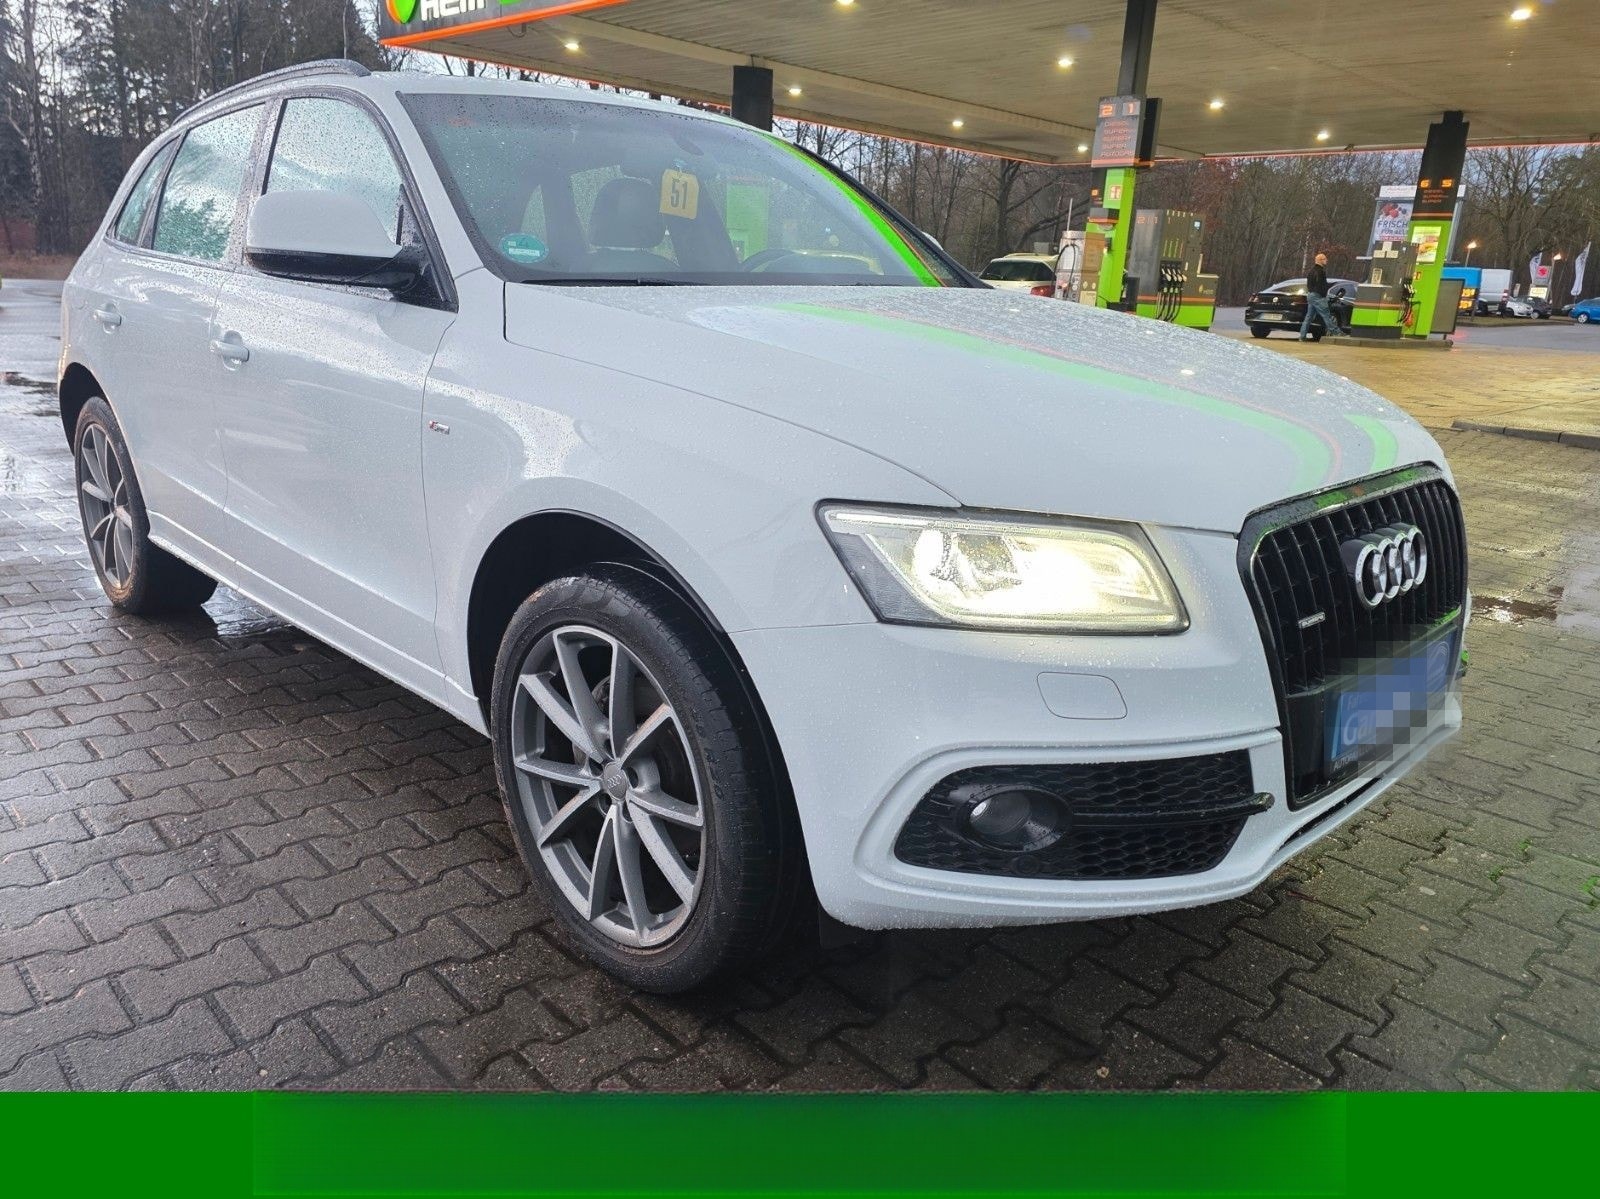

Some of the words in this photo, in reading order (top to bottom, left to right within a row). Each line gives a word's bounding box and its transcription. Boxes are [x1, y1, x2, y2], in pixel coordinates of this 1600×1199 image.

[1101, 104, 1113, 116] 2
[1420, 179, 1430, 188] 6
[670, 178, 690, 209] 51
